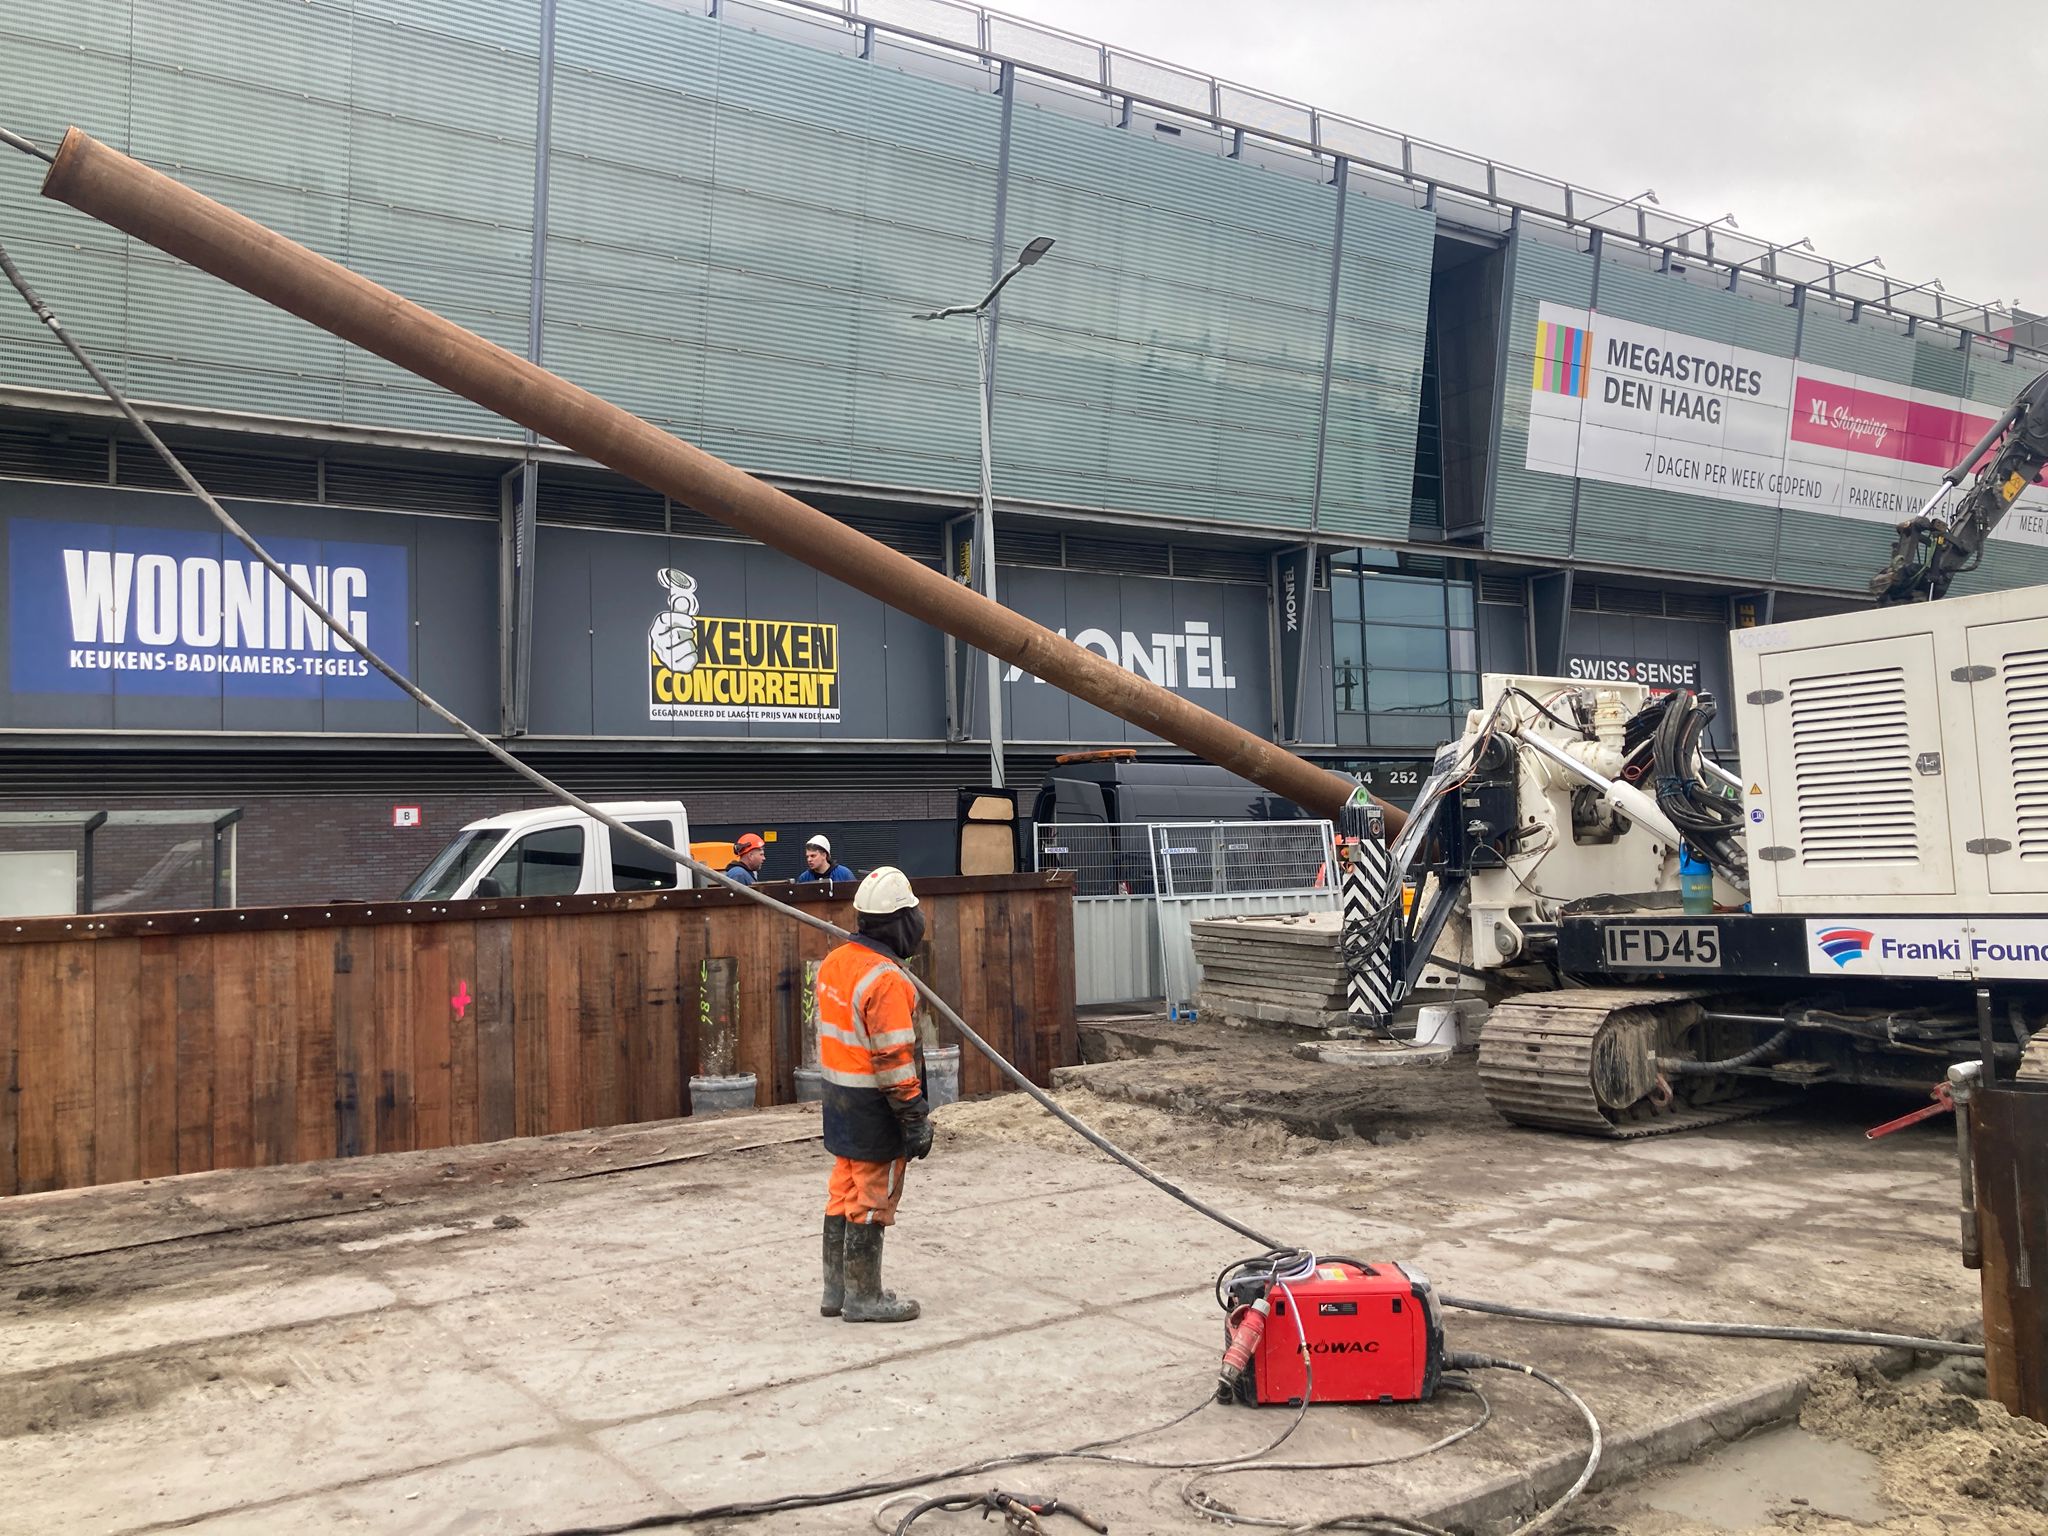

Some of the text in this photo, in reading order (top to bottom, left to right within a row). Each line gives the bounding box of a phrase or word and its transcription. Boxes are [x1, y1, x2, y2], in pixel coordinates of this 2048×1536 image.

[1607, 338, 1762, 397] MEGASTORES
[1604, 376, 1721, 425] DEN HAAG
[1809, 398, 1888, 448] XL Shopping
[1644, 453, 1652, 472] 7
[1657, 455, 1700, 480] DAGEN
[1704, 463, 1727, 484] PER
[1732, 467, 1765, 491] WEEK
[1769, 474, 1823, 499] GEOPEND
[1849, 487, 1902, 512] PARKEREN
[1906, 495, 1937, 516] VANF
[2020, 515, 2044, 534] MEER
[63, 549, 368, 653] WOONING
[698, 619, 834, 670] KEUKEN
[70, 650, 369, 678] KEUKENS-BADKAMERS-TEGELS
[1570, 658, 1694, 685] SWISS SENSE
[656, 667, 835, 706] CONCURRENT
[651, 708, 841, 722] GEGARANDEERD DE LAAGSTE PRIJS VAN NEDERLAND
[1345, 771, 1418, 784] 44 252
[404, 811, 410, 821] B
[1608, 929, 1718, 963] IFD45
[1881, 938, 1961, 961] Franki
[1297, 1340, 1380, 1355] ROWAC
